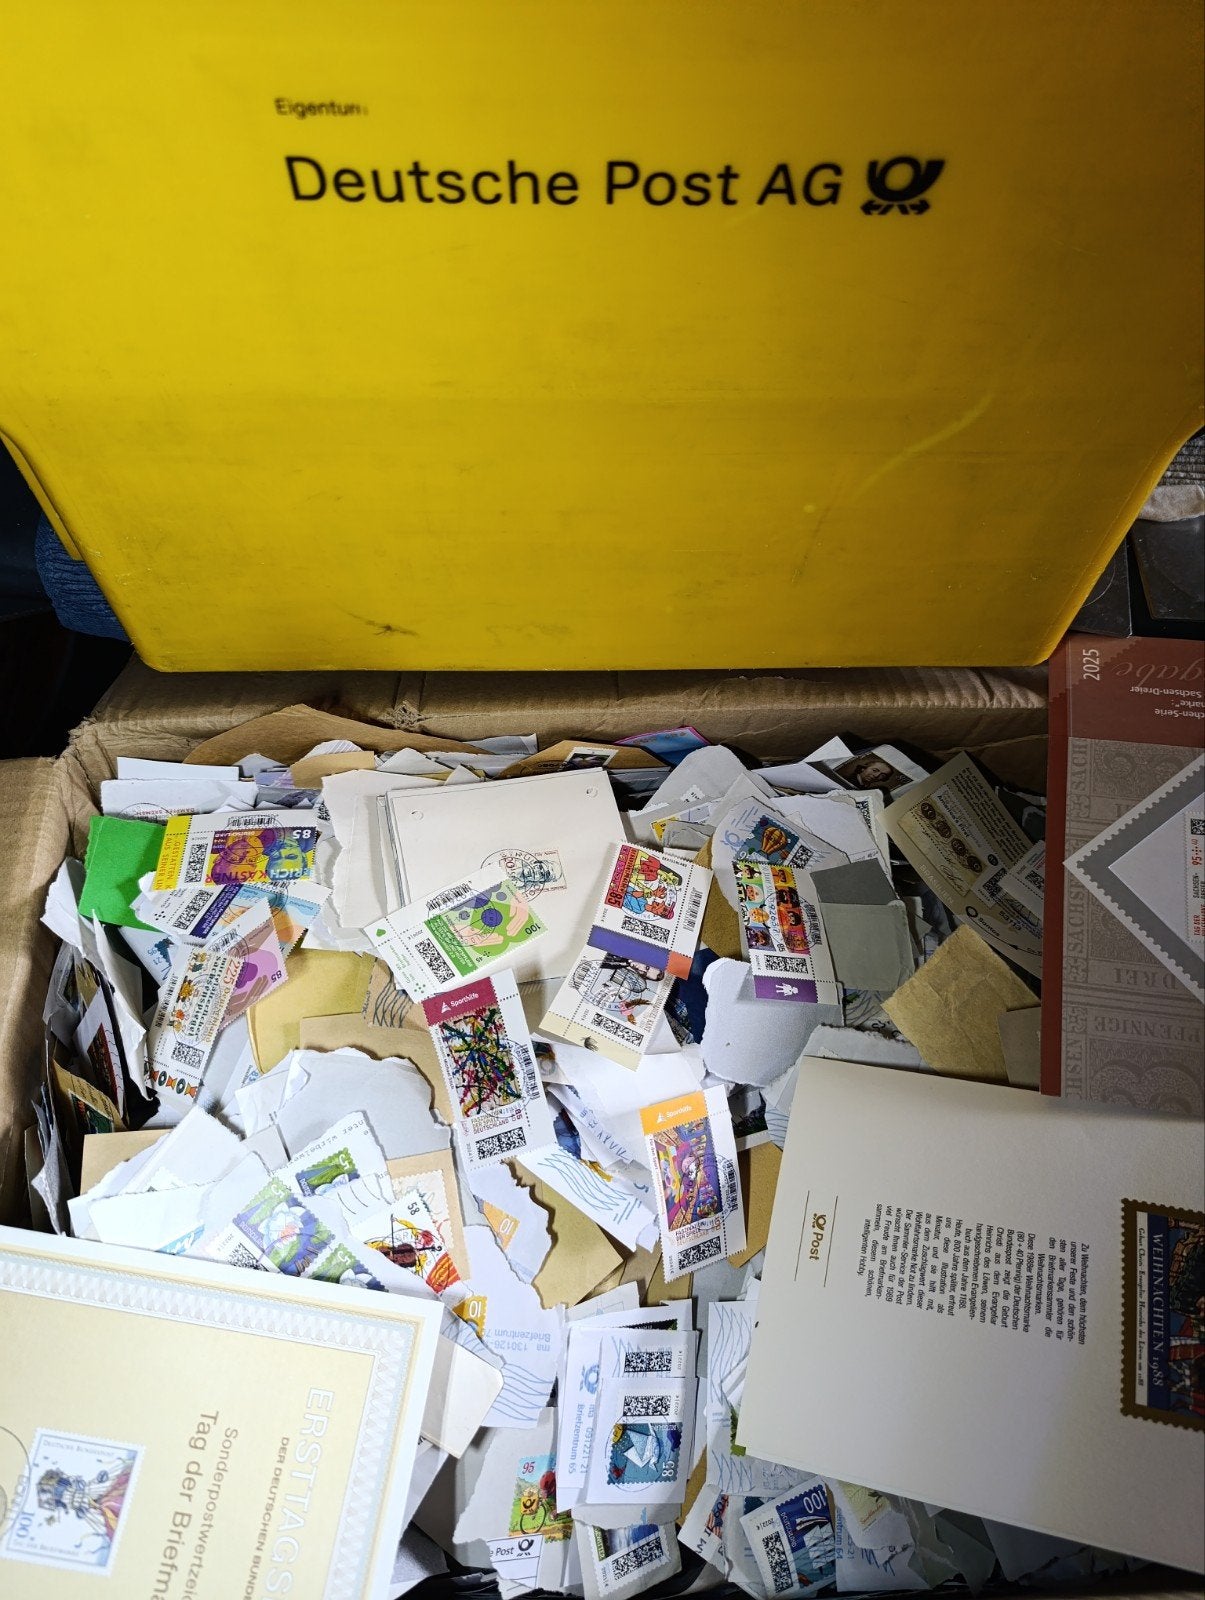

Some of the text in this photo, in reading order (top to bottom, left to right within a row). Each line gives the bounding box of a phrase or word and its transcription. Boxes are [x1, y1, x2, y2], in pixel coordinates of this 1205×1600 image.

[285, 155, 844, 206] Deutsche Post AG
[1082, 648, 1100, 681] 2025
[1129, 686, 1202, 698] Sachsen-Dreier
[292, 829, 312, 839] 85
[205, 868, 311, 883] ERICH KÄSTNER
[608, 891, 623, 905] 85
[525, 923, 542, 936] 100
[978, 916, 1000, 937] Santos
[223, 959, 240, 985] 225
[450, 992, 479, 1008] Sporthilfe
[883, 1220, 891, 1240] Freude
[985, 1225, 993, 1253] Heinrichs
[996, 1227, 1004, 1246] Christi
[809, 1232, 824, 1261] Post
[870, 1240, 878, 1261] diesem
[881, 1245, 887, 1254] am
[943, 1237, 951, 1253] diese
[1027, 1234, 1035, 1250] Diese
[952, 1253, 960, 1270] Jahre
[1016, 1249, 1023, 1257] 40
[1026, 1252, 1034, 1273] 1988er
[910, 1263, 918, 1273] Not
[1069, 1268, 1077, 1285] Feste
[961, 1273, 969, 1291] Jahre
[993, 1271, 1001, 1285] dem
[1001, 1229, 1014, 1327] Bundespost zeigt die Geburt
[1057, 1277, 1066, 1292] Tage,
[886, 1286, 894, 1302] 1989
[896, 1291, 904, 1304] Post
[1046, 1255, 1056, 1321] Briefmarkensammler
[1078, 1243, 1089, 1344] Zu Weihnachten, dem höchsten
[917, 1290, 925, 1309] dieser
[948, 1295, 956, 1316] erfreut
[980, 1299, 988, 1323] seinem
[1012, 1296, 1020, 1330] Deutschen
[1056, 1298, 1064, 1324] gehören
[1147, 1233, 1164, 1387] WEIHNACHTEN 1988
[494, 1328, 551, 1343] Briefzentrum
[188, 1410, 219, 1451] Tag
[570, 1403, 585, 1460] Briefzentrum
[277, 1436, 290, 1464] DER
[522, 1462, 535, 1474] 95
[661, 1460, 675, 1477] 85
[178, 1460, 203, 1503] der
[255, 1466, 283, 1552] DEUTSCHEN
[804, 1490, 827, 1514] 100
[495, 1546, 514, 1556] Post
